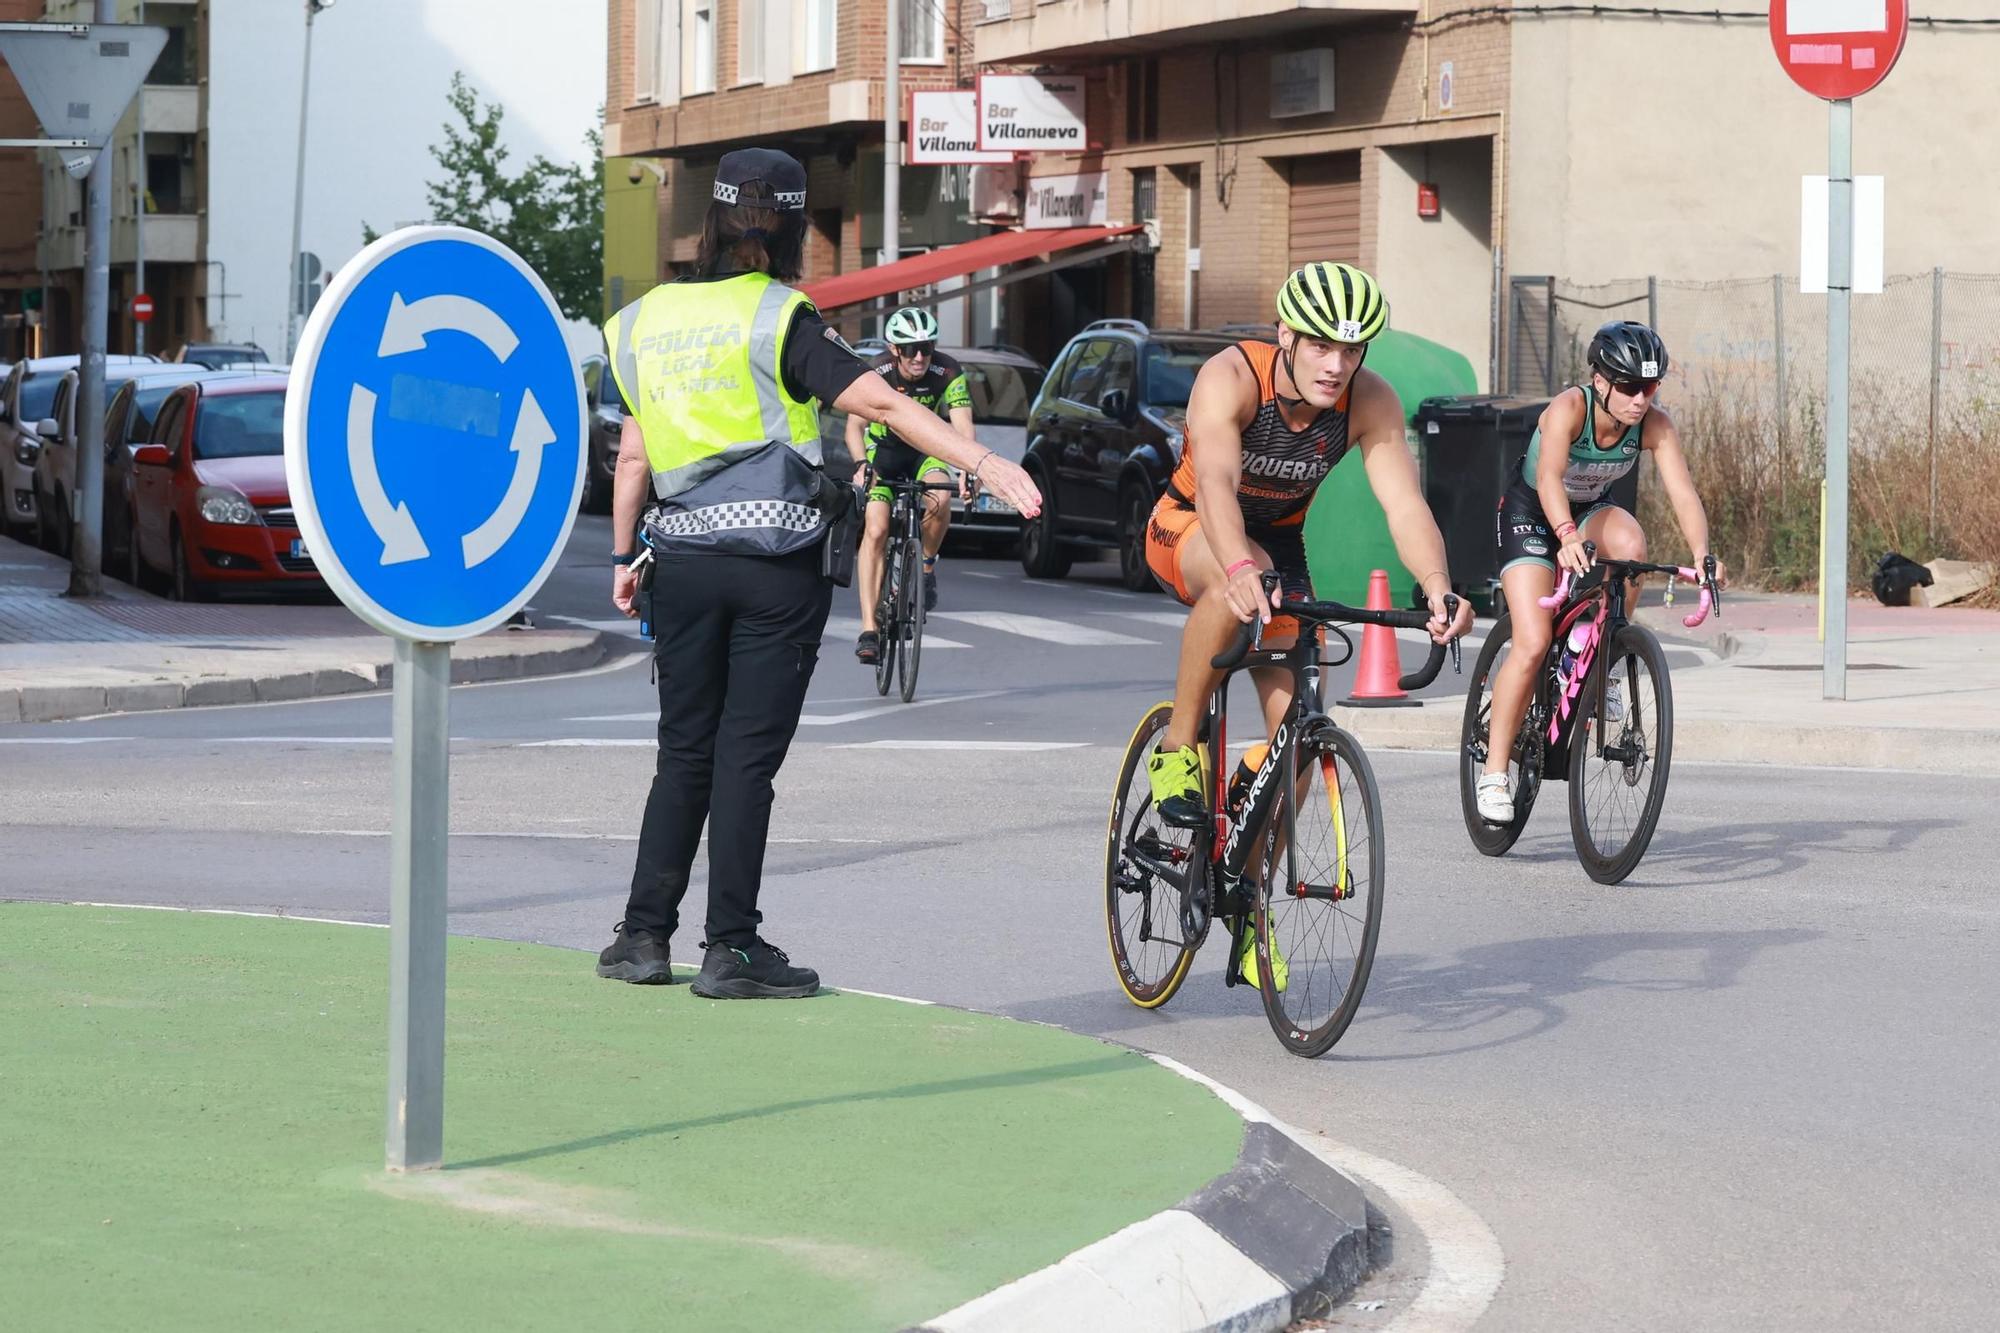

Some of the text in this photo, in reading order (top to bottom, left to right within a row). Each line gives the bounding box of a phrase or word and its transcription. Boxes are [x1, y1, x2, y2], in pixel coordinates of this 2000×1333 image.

[988, 104, 1017, 118] Bar
[919, 118, 948, 132] Bar
[987, 123, 1078, 139] Villanueva
[919, 137, 976, 151] Villanu
[1040, 186, 1084, 219] Villanueva
[1343, 328, 1355, 339] 74
[638, 324, 741, 360] POLICIA
[1644, 367, 1657, 376] 197
[1512, 525, 1532, 533] ITV
[1224, 723, 1287, 866] PINARELLO
